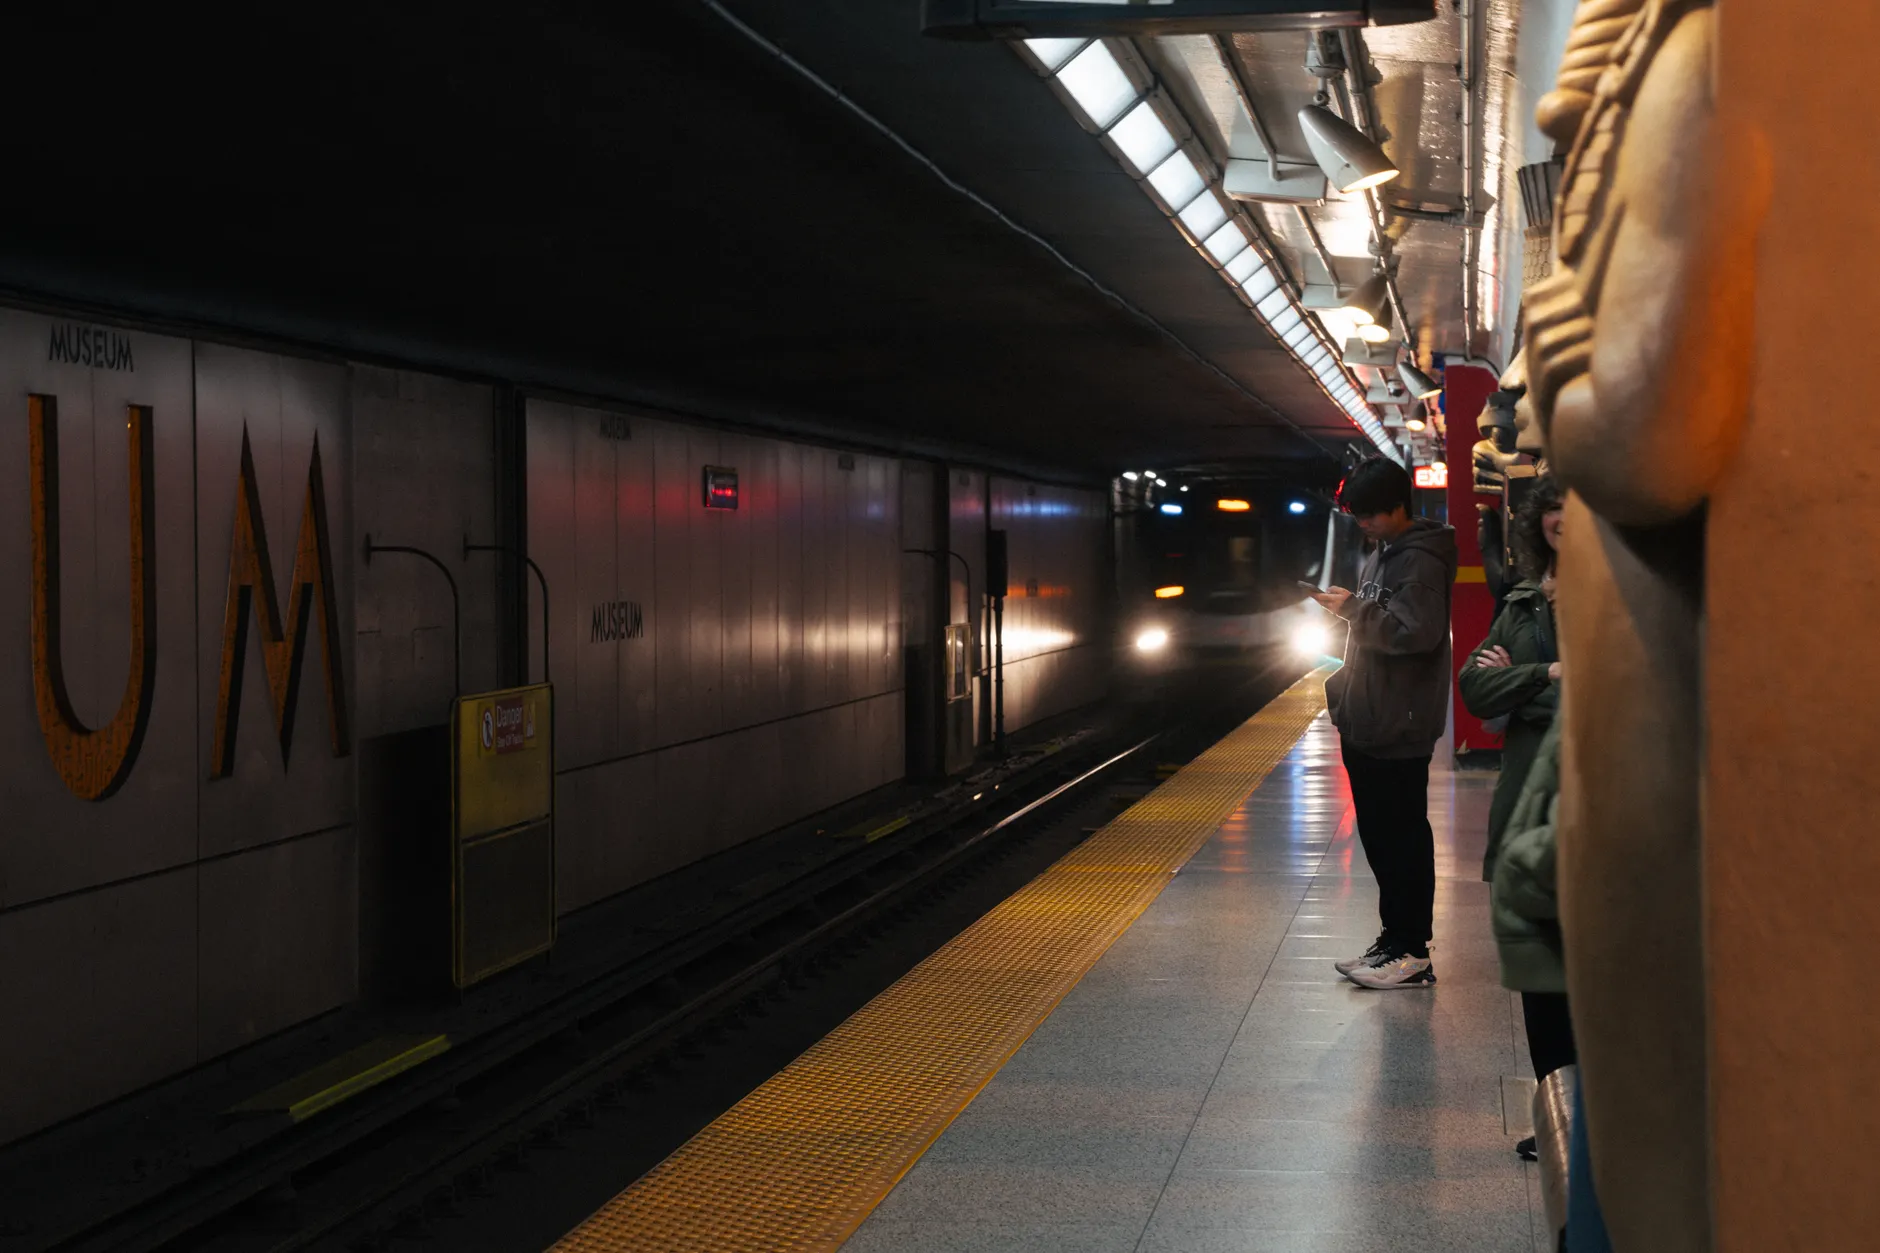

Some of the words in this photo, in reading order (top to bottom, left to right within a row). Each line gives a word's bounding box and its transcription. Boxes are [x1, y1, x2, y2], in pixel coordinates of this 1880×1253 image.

[49, 323, 133, 372] MUSEUM
[591, 601, 643, 643] MUSEUM
[497, 705, 522, 730] Danger
